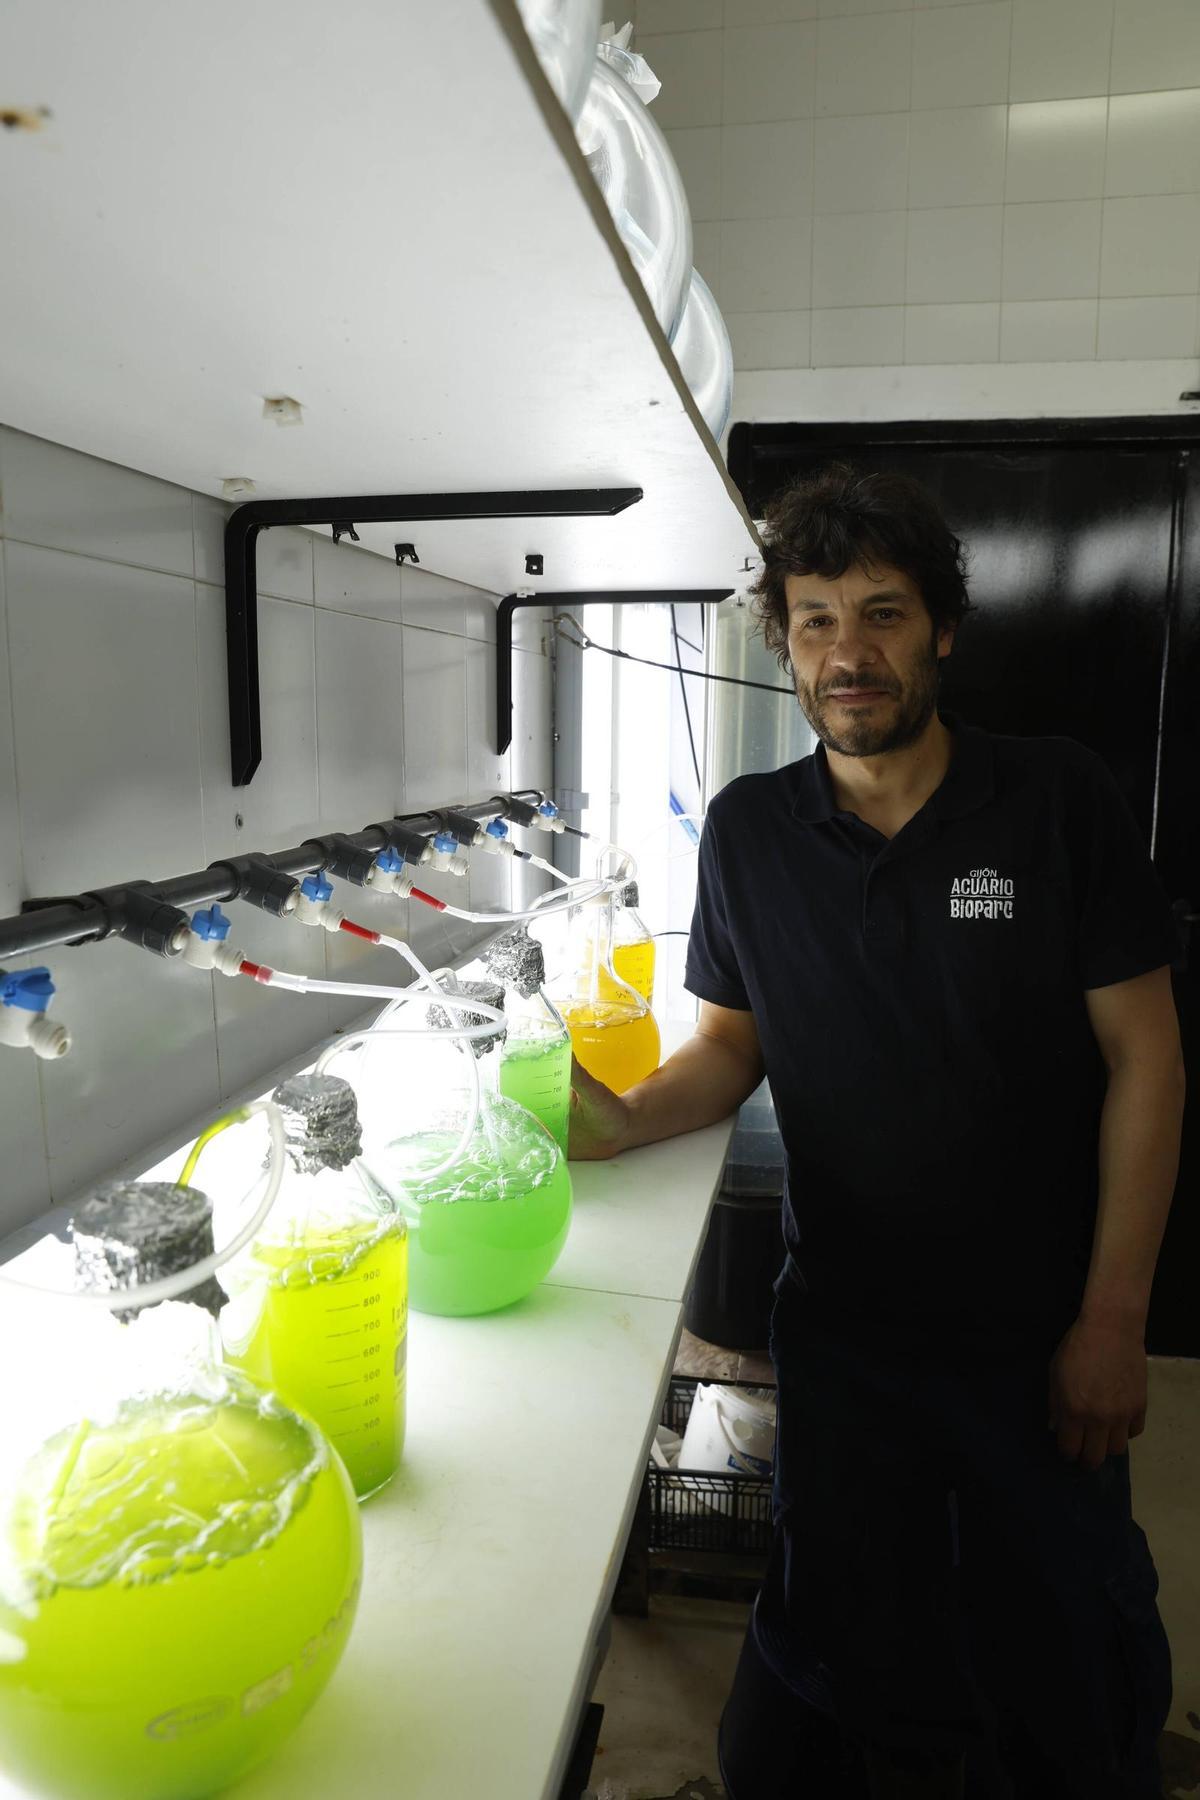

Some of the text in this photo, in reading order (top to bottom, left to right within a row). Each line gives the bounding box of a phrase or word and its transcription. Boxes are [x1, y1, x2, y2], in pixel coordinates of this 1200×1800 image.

[969, 867, 998, 879] GIJÓN
[950, 877, 1014, 896] ACUARIO
[362, 1292, 381, 1308] 800
[362, 1319, 381, 1332] 700
